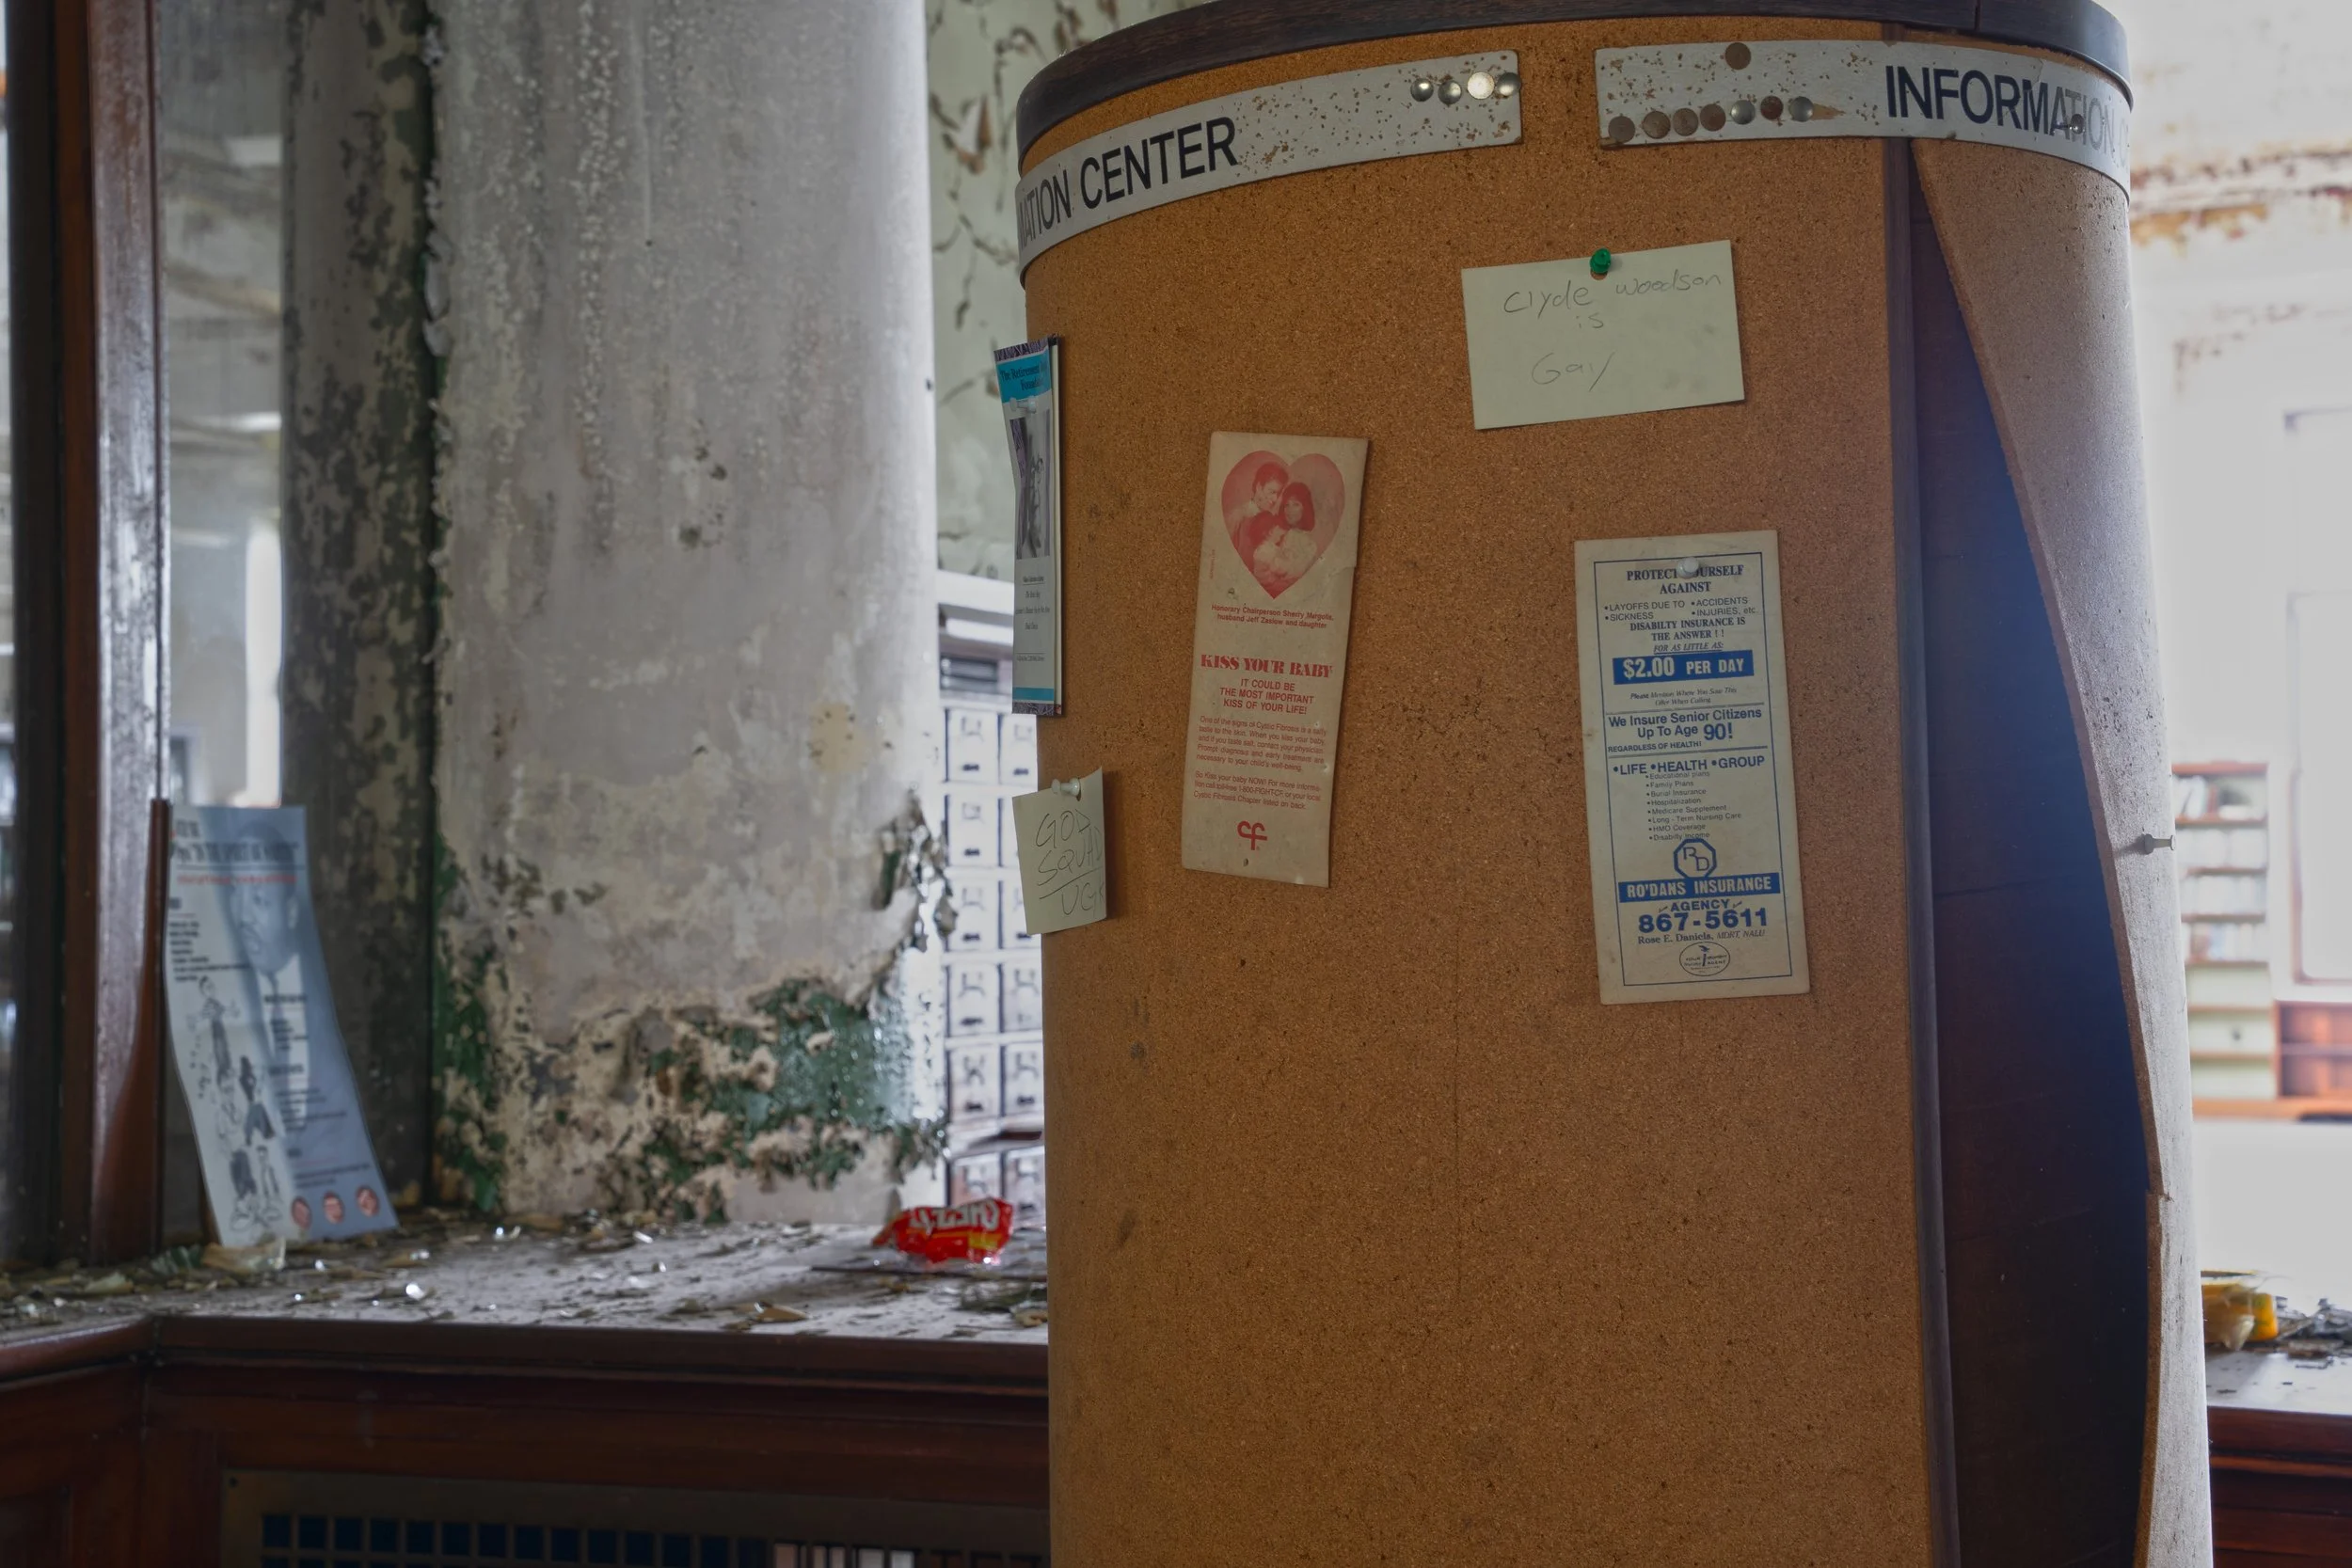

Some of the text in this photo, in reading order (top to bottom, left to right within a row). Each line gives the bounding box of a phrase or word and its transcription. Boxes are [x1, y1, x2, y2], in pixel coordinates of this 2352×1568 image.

[1886, 65, 2115, 155] INFORMATION
[1019, 117, 1238, 249] ATION CENTER
[1576, 312, 1604, 329] is
[1532, 351, 1615, 391] Gay
[1627, 565, 1744, 581] PROTECT OURSELF
[1660, 582, 1711, 594] AGAINST
[1212, 604, 1240, 613] Honorary
[1243, 606, 1281, 616] Chairperson
[1282, 610, 1304, 619] Sherry
[1610, 602, 1649, 611] LAYOFFS
[1696, 597, 1748, 607] ACCIDENTS
[1610, 611, 1654, 621] SICKNESS
[1681, 618, 1733, 628] INSURANCE
[1737, 617, 1745, 626] IS
[1299, 620, 1327, 629] daughter
[1652, 630, 1711, 641] THE ANSWER
[1654, 644, 1668, 653] FOR
[1683, 642, 1708, 651] LITTLE
[1200, 654, 1332, 678] KISS YOUR BABY
[1623, 657, 1744, 680] $2.00 PER DAY
[1241, 678, 1295, 691] IT COULD BE
[1219, 687, 1314, 704] THE MOST IMPORTANT
[1246, 701, 1257, 709] OF
[1261, 704, 1283, 712] YOUR
[1286, 705, 1308, 715] LIFE!
[1609, 708, 1762, 727] We Insure Senior Citizens
[1249, 730, 1266, 738] When
[1268, 732, 1279, 740] you
[1637, 722, 1733, 740] Up To Age 90!
[1197, 744, 1218, 752] Prompt
[1608, 744, 1656, 752] REGARDLESS
[1620, 756, 1765, 775] LIFE HEALTH GROUP
[1036, 809, 1090, 848] GOD
[1038, 826, 1103, 886] SQUAD
[1627, 876, 1772, 897] RO'DANS INSURANCE
[1670, 898, 1731, 912] AGENCY
[1638, 908, 1768, 934] 867-5611
[1638, 935, 1661, 944] Rose
